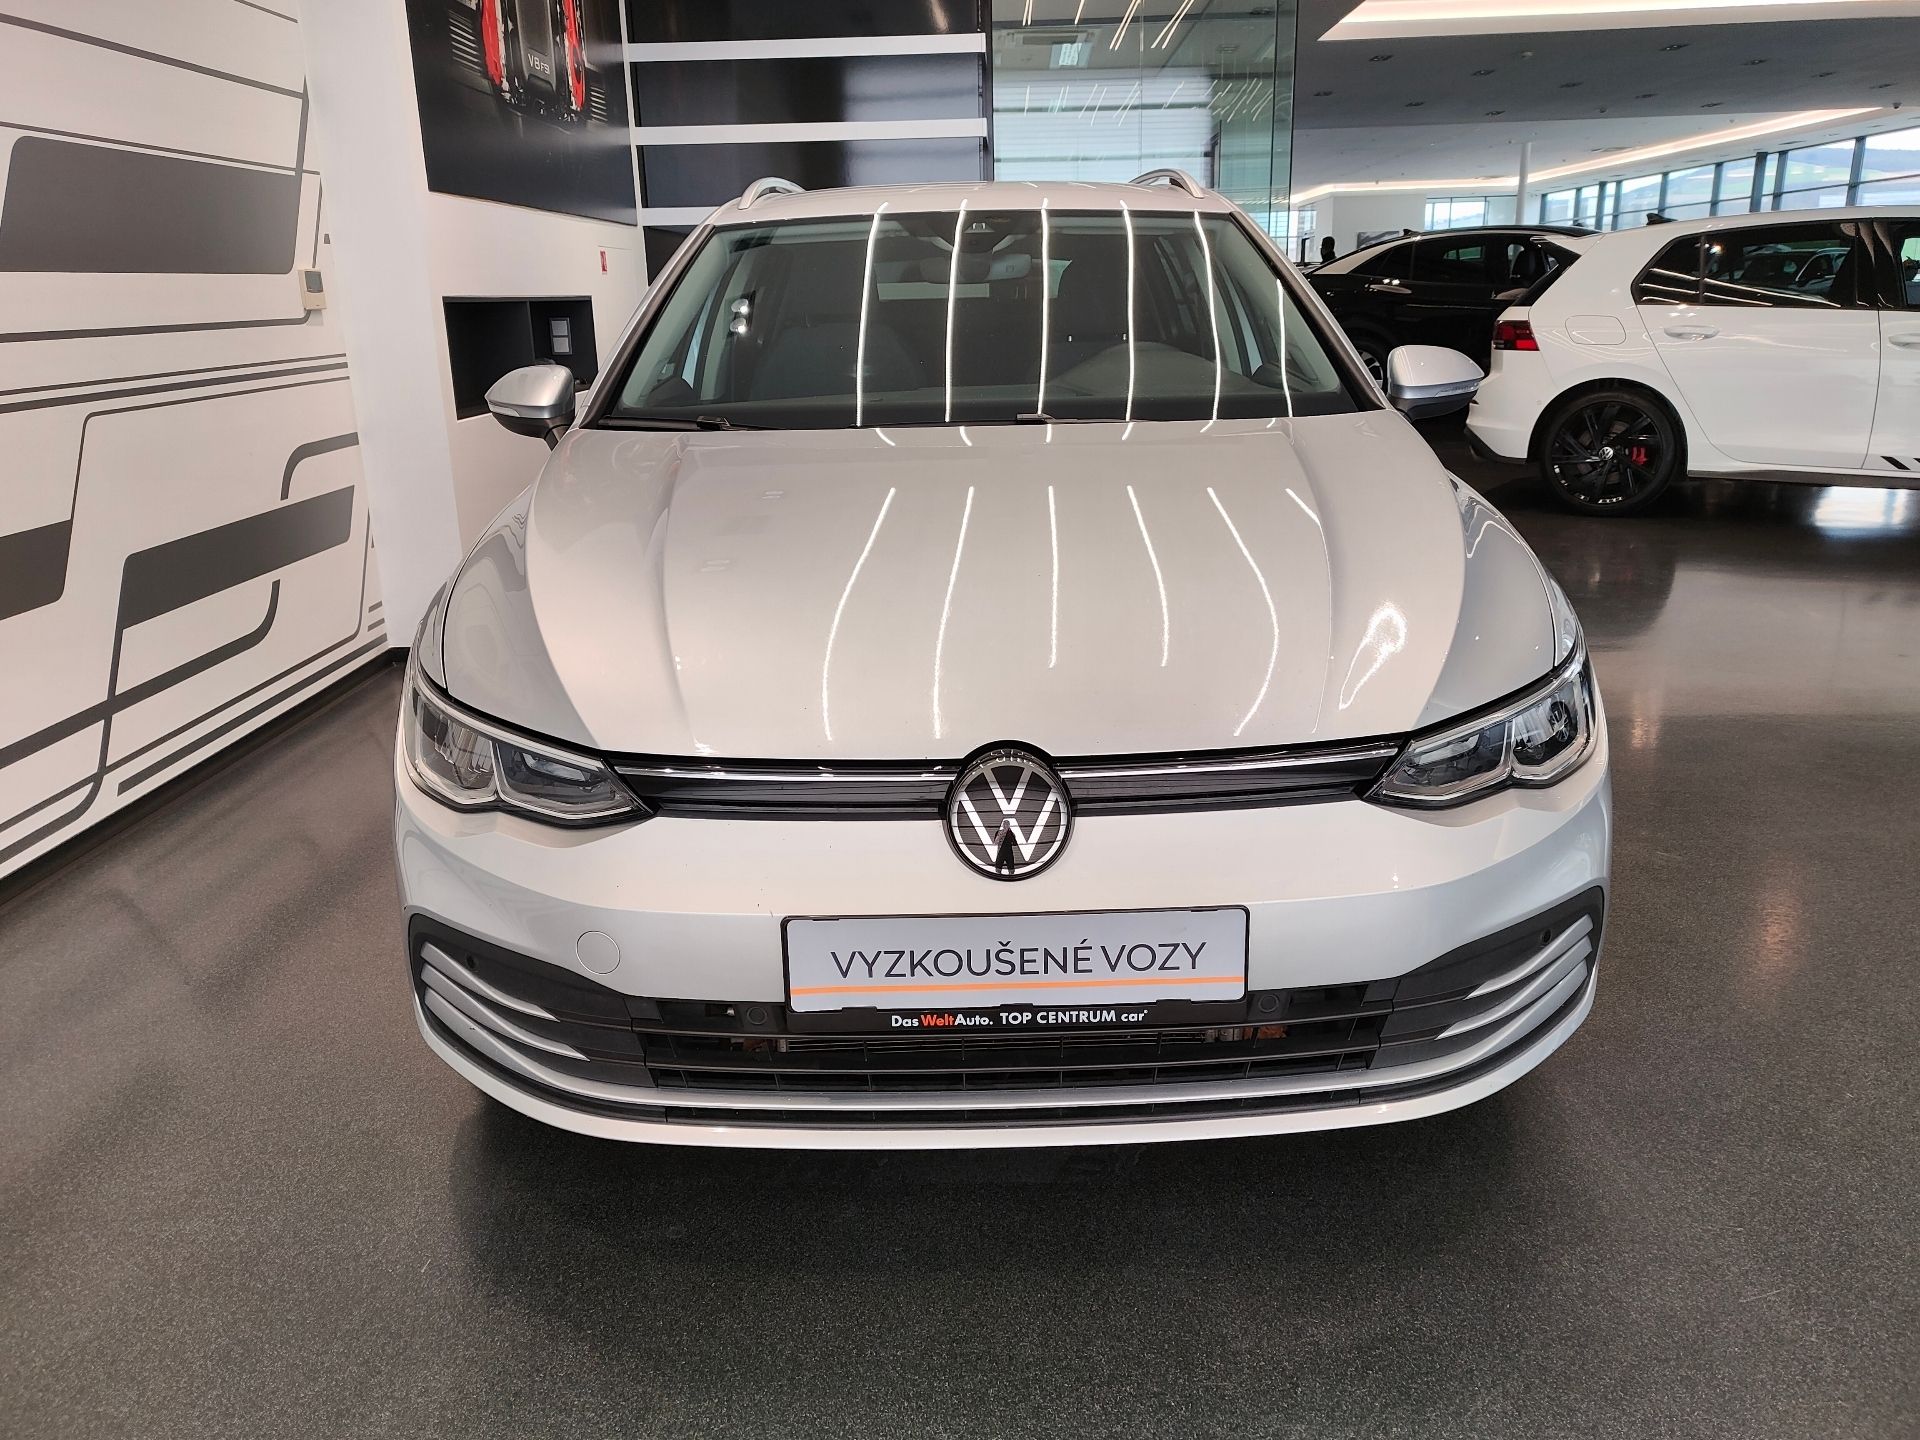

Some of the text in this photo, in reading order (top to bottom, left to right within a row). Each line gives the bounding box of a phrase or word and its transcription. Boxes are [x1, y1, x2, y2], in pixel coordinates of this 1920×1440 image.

[830, 938, 1207, 979] VYZKOUŠENÉ VOZY
[891, 1015, 919, 1027] Das
[999, 1011, 1032, 1025] TOP
[1036, 1009, 1116, 1024] CENTRUM
